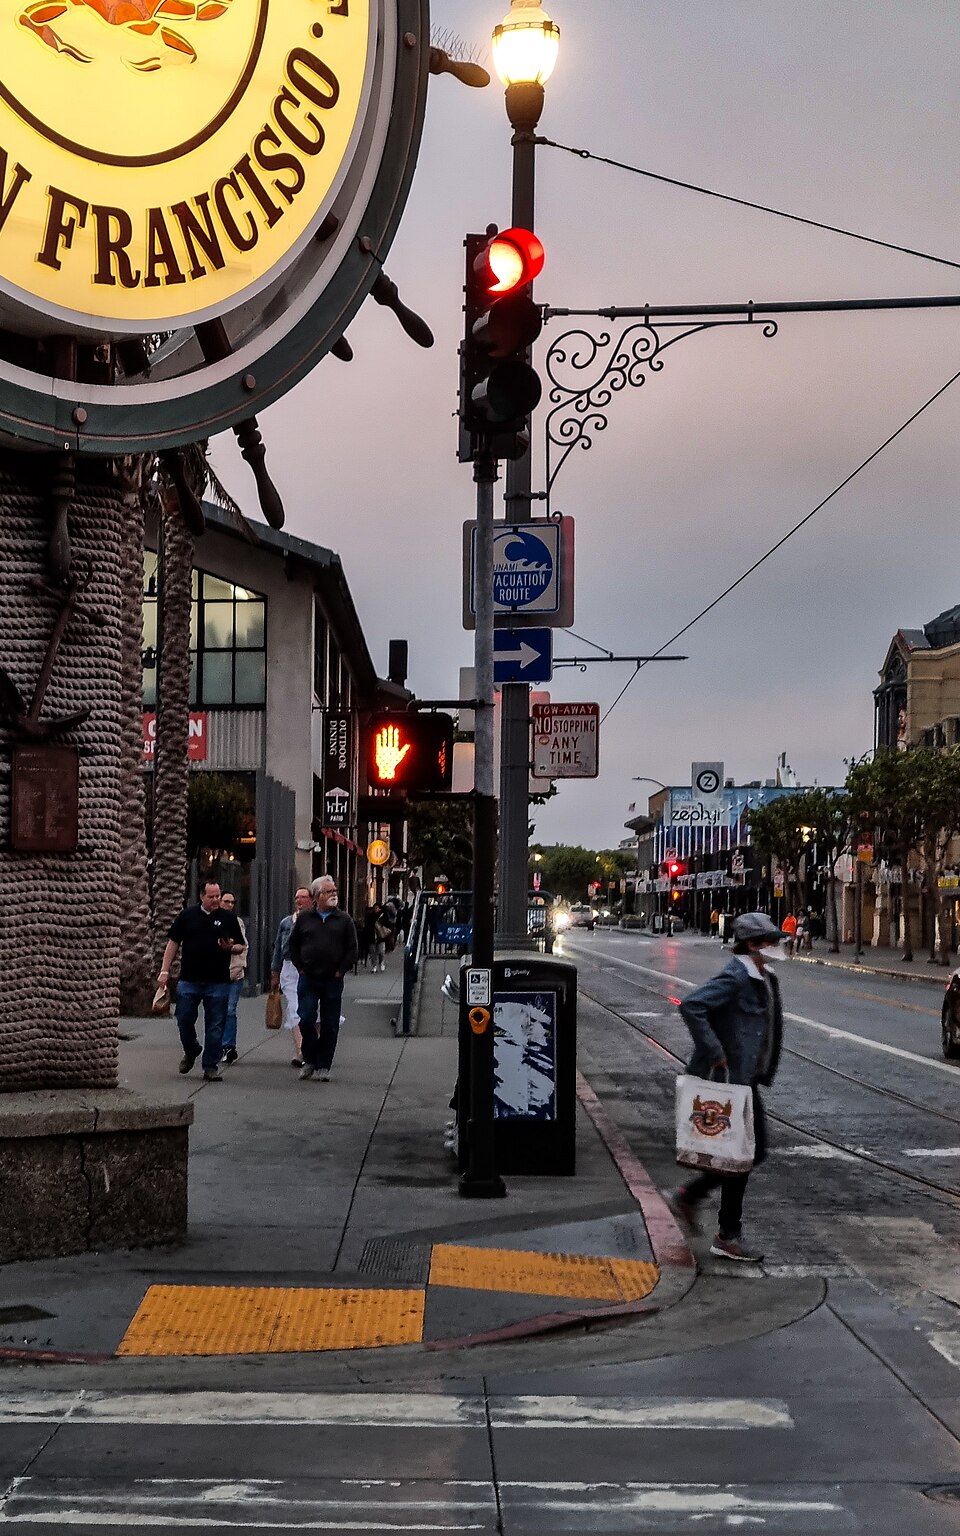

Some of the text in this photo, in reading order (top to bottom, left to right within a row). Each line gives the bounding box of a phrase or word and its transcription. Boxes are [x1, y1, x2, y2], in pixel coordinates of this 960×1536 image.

[36, 46, 342, 289] FRANCISCO
[499, 588, 530, 601] ROUTE
[538, 705, 594, 715] TOW-AWAY
[535, 716, 595, 734] NO STOPPING
[329, 719, 338, 757] DINING
[338, 719, 347, 770] OUTDOOR
[551, 736, 579, 750] ANY
[550, 751, 582, 765] TIME
[703, 776, 713, 788] Z
[671, 802, 725, 827] zephyr
